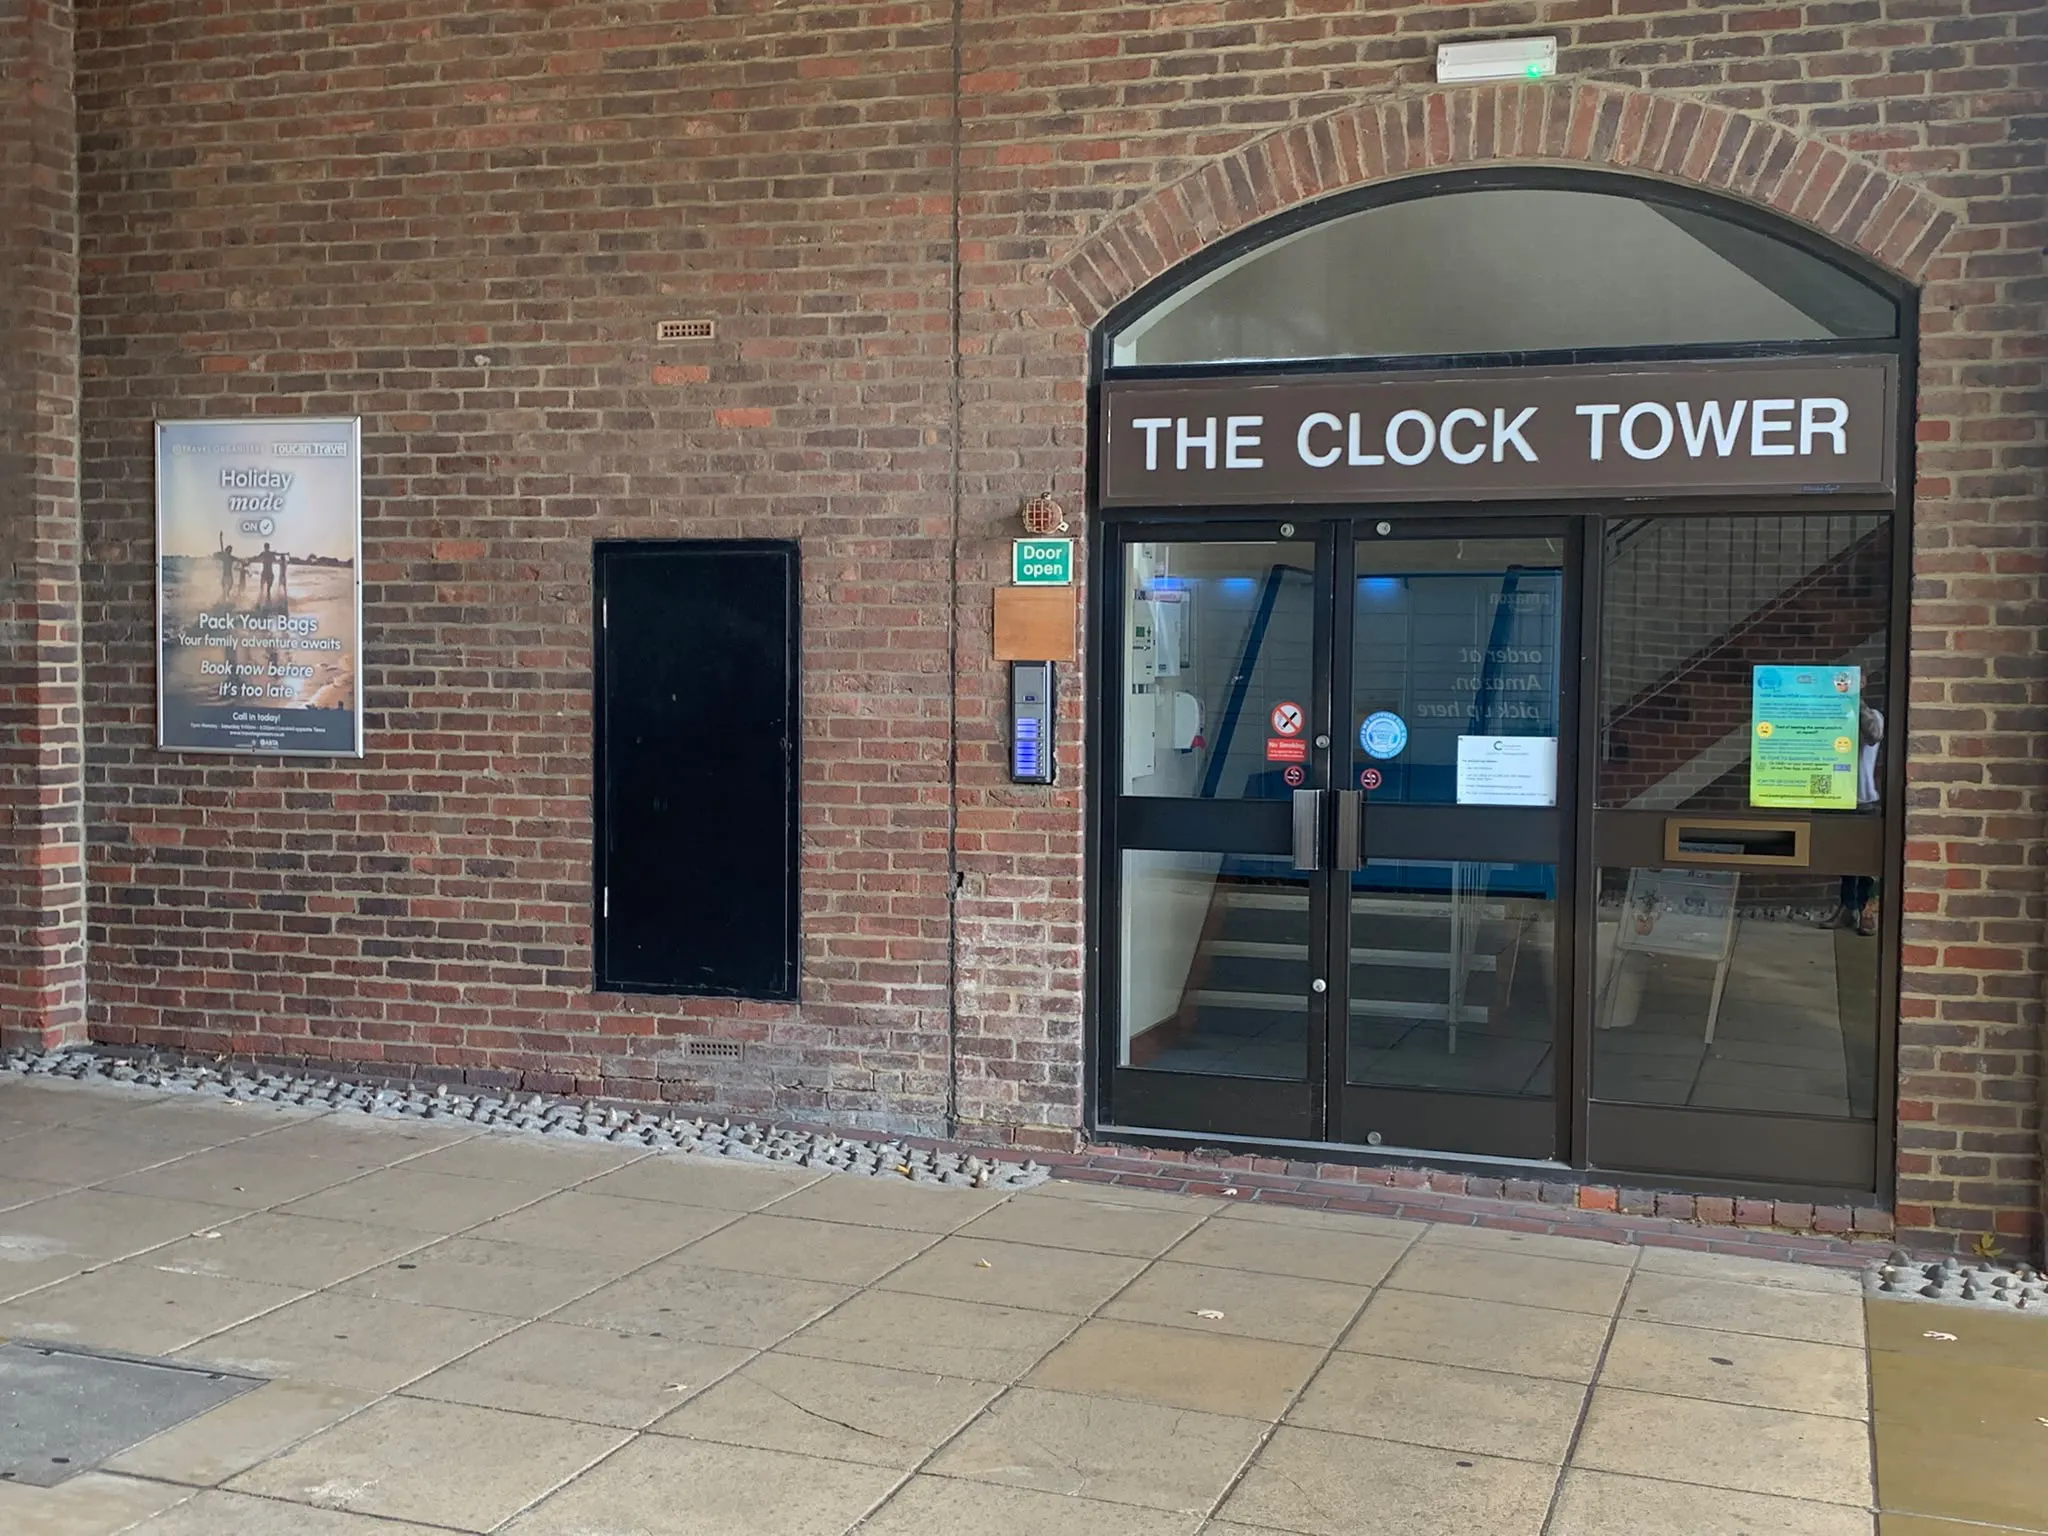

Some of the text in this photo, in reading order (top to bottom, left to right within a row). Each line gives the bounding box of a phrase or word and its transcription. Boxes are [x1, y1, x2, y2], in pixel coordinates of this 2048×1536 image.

[1132, 397, 1849, 471] THE CLOCK TOWER
[273, 443, 346, 456] Toucan Travel
[221, 470, 292, 491] Holiday
[230, 492, 284, 511] mode
[243, 522, 258, 531] ON
[1024, 546, 1062, 560] Door
[1024, 563, 1062, 578] open
[200, 613, 317, 635] Pack Your Bags
[178, 634, 341, 649] Your family adventure awaits
[201, 660, 313, 677] Book now before
[219, 683, 237, 696] it's
[241, 685, 263, 697] too
[233, 712, 281, 724] Call in today!
